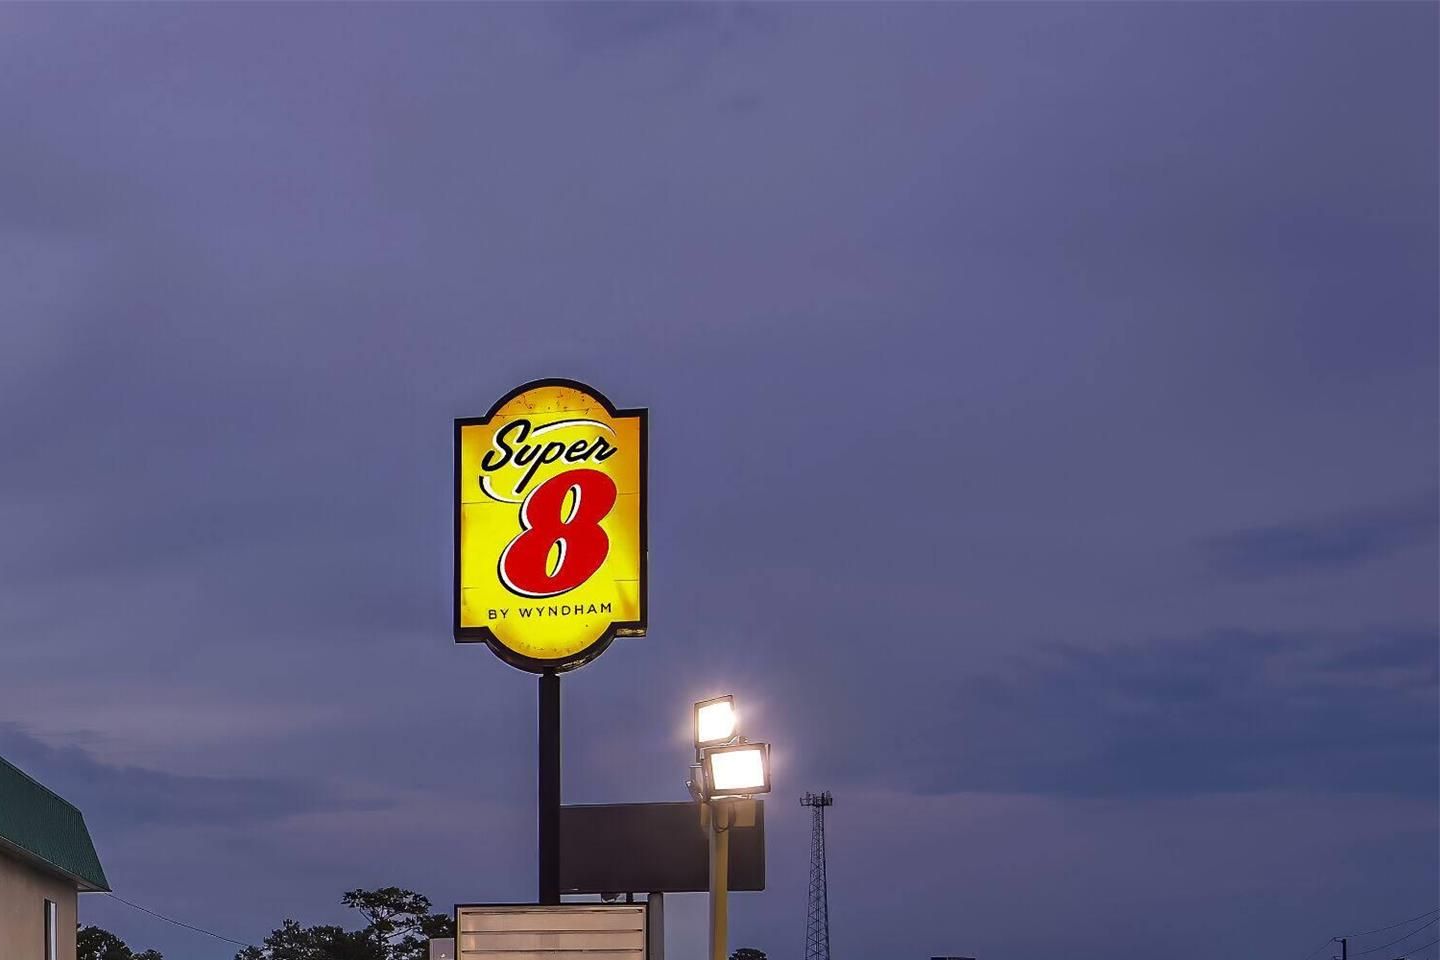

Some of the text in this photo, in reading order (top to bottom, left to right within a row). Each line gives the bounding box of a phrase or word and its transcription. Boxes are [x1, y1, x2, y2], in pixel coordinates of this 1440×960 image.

[480, 418, 618, 494] Super
[497, 468, 617, 599] 8
[488, 602, 612, 620] BY WYNDHAM
